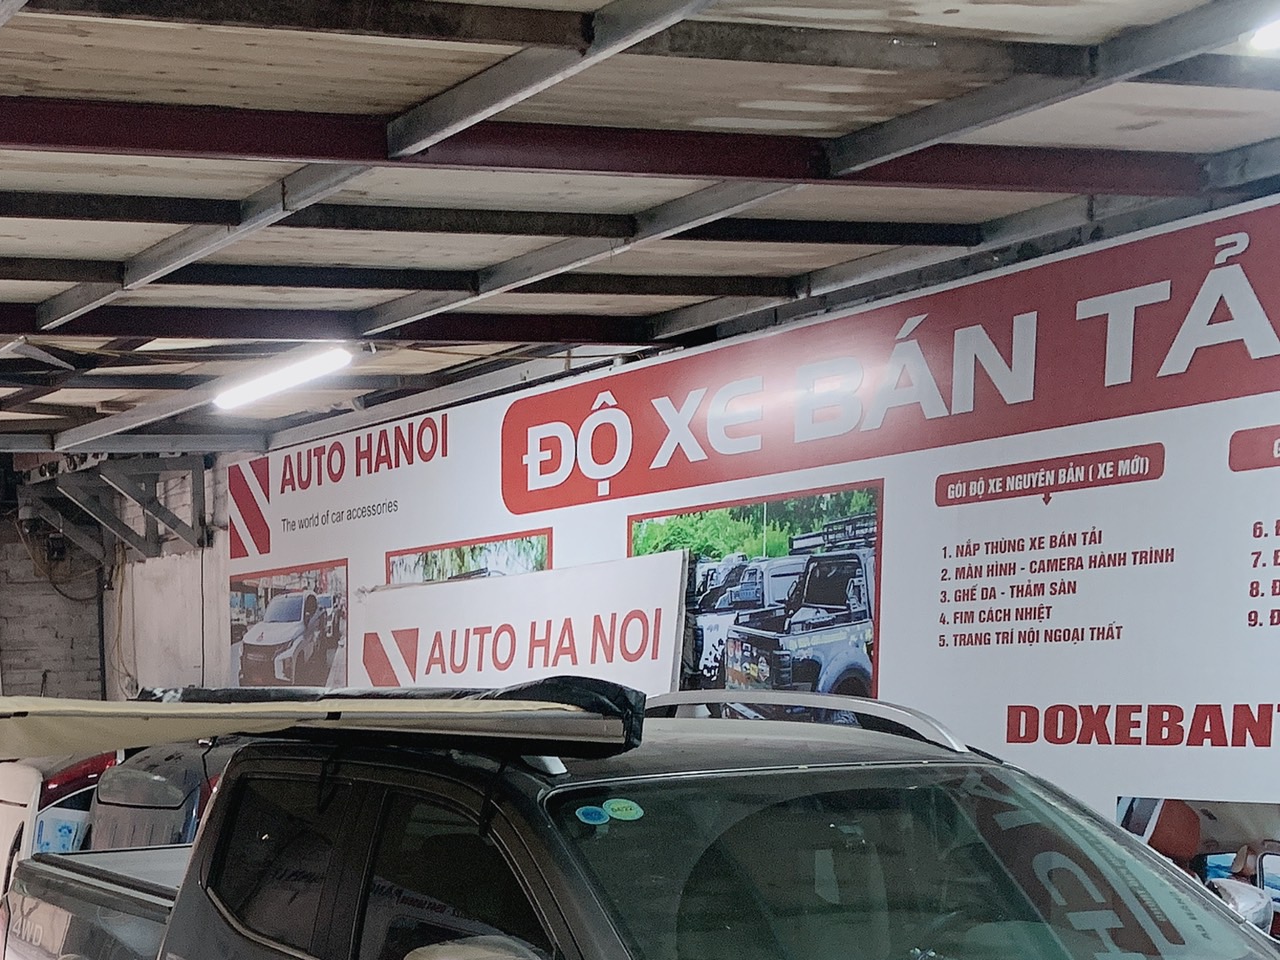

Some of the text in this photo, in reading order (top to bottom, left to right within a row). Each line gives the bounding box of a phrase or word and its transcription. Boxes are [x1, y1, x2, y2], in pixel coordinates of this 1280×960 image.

[523, 392, 633, 496] ĐỘ
[649, 376, 765, 470] XE
[793, 311, 1038, 444] BÁN
[280, 413, 448, 494] AUTO HANOI
[987, 477, 1003, 494] XE
[1005, 468, 1054, 492] NGUYÊN
[1058, 461, 1085, 484] BẢN
[1097, 462, 1114, 480] XE
[281, 498, 399, 532] The world of car accessories
[1252, 521, 1268, 538] 6.
[942, 546, 952, 559] 1.
[984, 537, 1025, 555] THÙNG
[1028, 536, 1045, 551] XE
[1049, 530, 1077, 549] BÁN
[1081, 526, 1103, 546] TẢI
[940, 568, 951, 582] 2.
[954, 563, 983, 580] MÀN
[986, 560, 1017, 578] HÌNH
[1029, 556, 1084, 574] CAMERA
[1088, 551, 1127, 569] HÀNH
[1131, 546, 1175, 566] TRÌNH
[1251, 551, 1266, 568] 7.
[939, 590, 950, 603] 3.
[953, 584, 978, 603] GHẾ
[980, 586, 997, 601] DA
[1009, 579, 1045, 598] THẢM
[1049, 579, 1077, 596] SÀN
[1249, 580, 1265, 597] 8.
[939, 603, 1053, 625] 4. FIM CÁCH NHIỆT
[1247, 610, 1263, 627] 9.
[425, 623, 516, 676] AUTO
[938, 621, 1124, 648] 5. TRANG TRÍ NỘI NGOẠI THẤT
[1006, 703, 1280, 748] DOXEBAN
